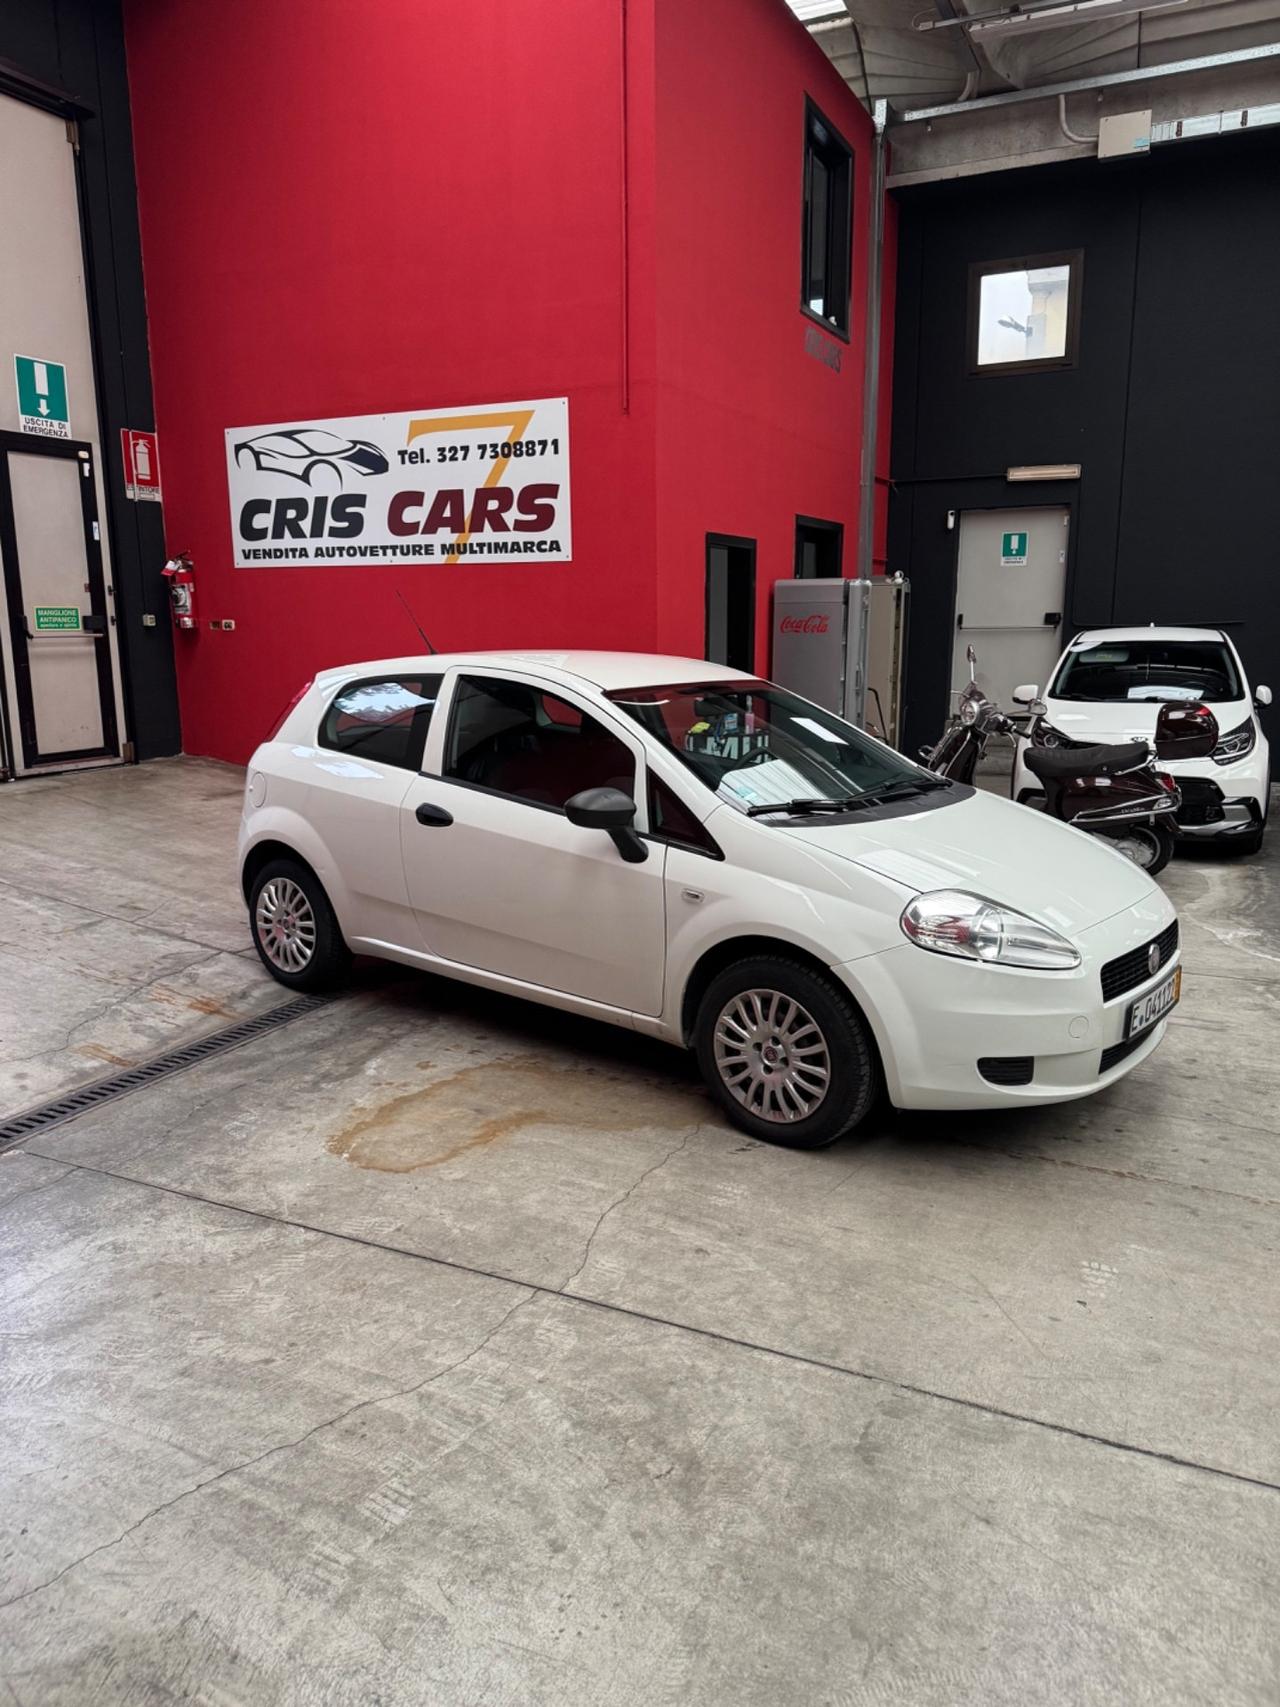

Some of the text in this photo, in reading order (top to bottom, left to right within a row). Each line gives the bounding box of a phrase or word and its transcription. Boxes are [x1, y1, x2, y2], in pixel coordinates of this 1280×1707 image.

[23, 426, 69, 438] EMERGENZA
[24, 417, 54, 428] USCITA
[397, 438, 560, 466] Tel. 327 7308871
[239, 483, 560, 542] CRIS CARS
[242, 539, 562, 561] VENDITA AUTOVETTURE MULTIMARCA
